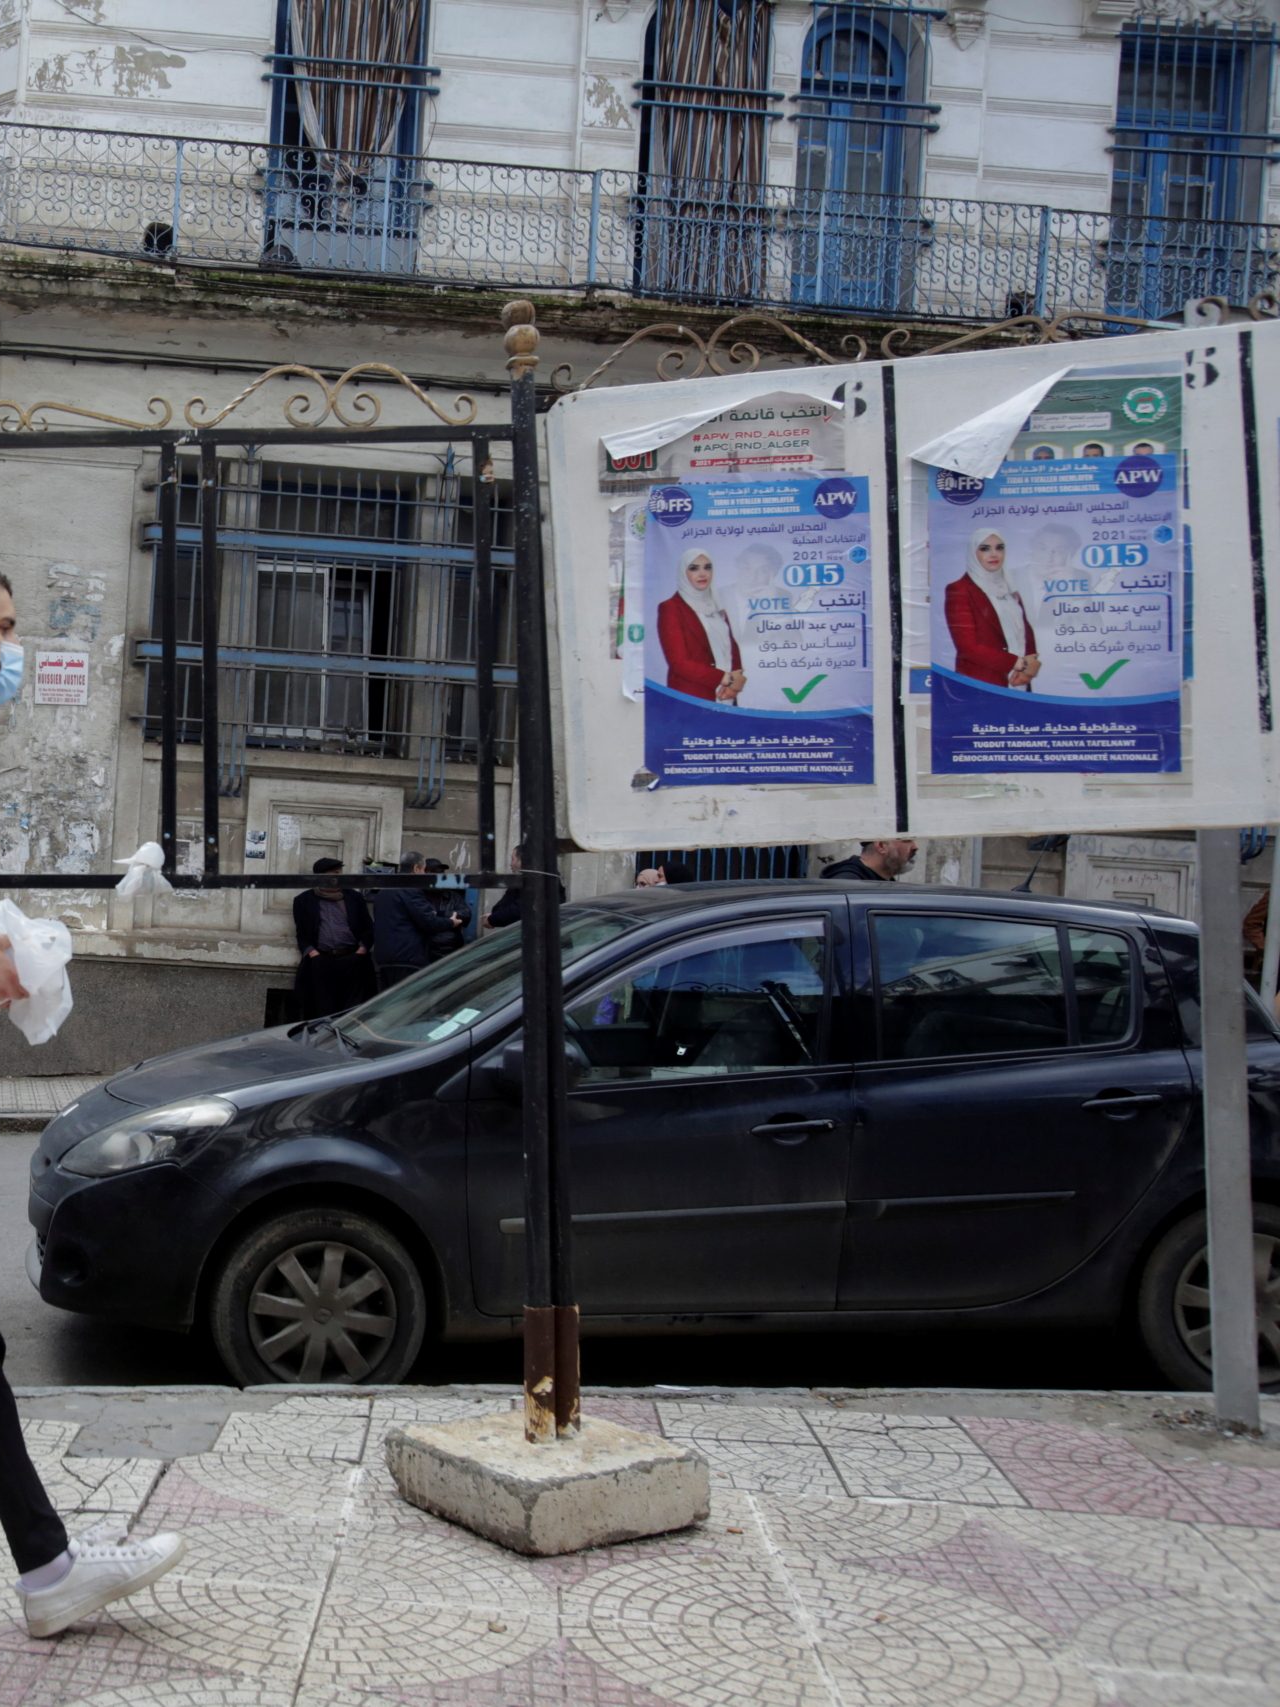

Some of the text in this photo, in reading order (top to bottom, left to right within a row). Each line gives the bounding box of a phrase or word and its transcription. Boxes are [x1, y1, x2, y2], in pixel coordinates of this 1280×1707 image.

[1185, 347, 1219, 389] 5
[781, 405, 827, 422] انتخب
[692, 428, 810, 441] #APW_RND_ALGER
[694, 440, 810, 452] #APC_RND_ALGER
[1114, 469, 1162, 484] APW
[958, 477, 983, 490] FFS
[669, 498, 692, 512] FFS
[814, 491, 857, 506] APW
[971, 502, 1129, 518] المجلس الشعبي لولاية الجزائر
[681, 522, 827, 539] المجلس الشعبي لولاية الجزائر
[1092, 530, 1125, 541] 2021
[793, 551, 823, 561] 2021
[1085, 544, 1143, 567] 015
[786, 564, 840, 586] 015
[1044, 579, 1089, 593] VOTE
[748, 597, 790, 610] VOTE
[1052, 601, 1160, 616] سي عبد الله منال
[757, 620, 855, 634] سي عبد الله منال
[1054, 640, 1161, 654] مديرة شركة خاصة
[758, 657, 856, 670] مديرة شركة خاصة
[38, 673, 85, 686] HUISSIER JUSTICE
[972, 723, 1006, 735] وطنية
[1008, 723, 1040, 735] سيادة
[682, 737, 714, 747] وطنية
[716, 736, 745, 746] سيادة
[1052, 740, 1086, 748] TANAYA
[756, 752, 787, 760] TANAYA
[952, 752, 1158, 763] DÉMOCRATIE LOCALE, SOUVERAINETÉ NATIONALE
[664, 764, 853, 775] DÉMOCRATIE LOCALE, SOUVERAINETÉ NATIONALE
